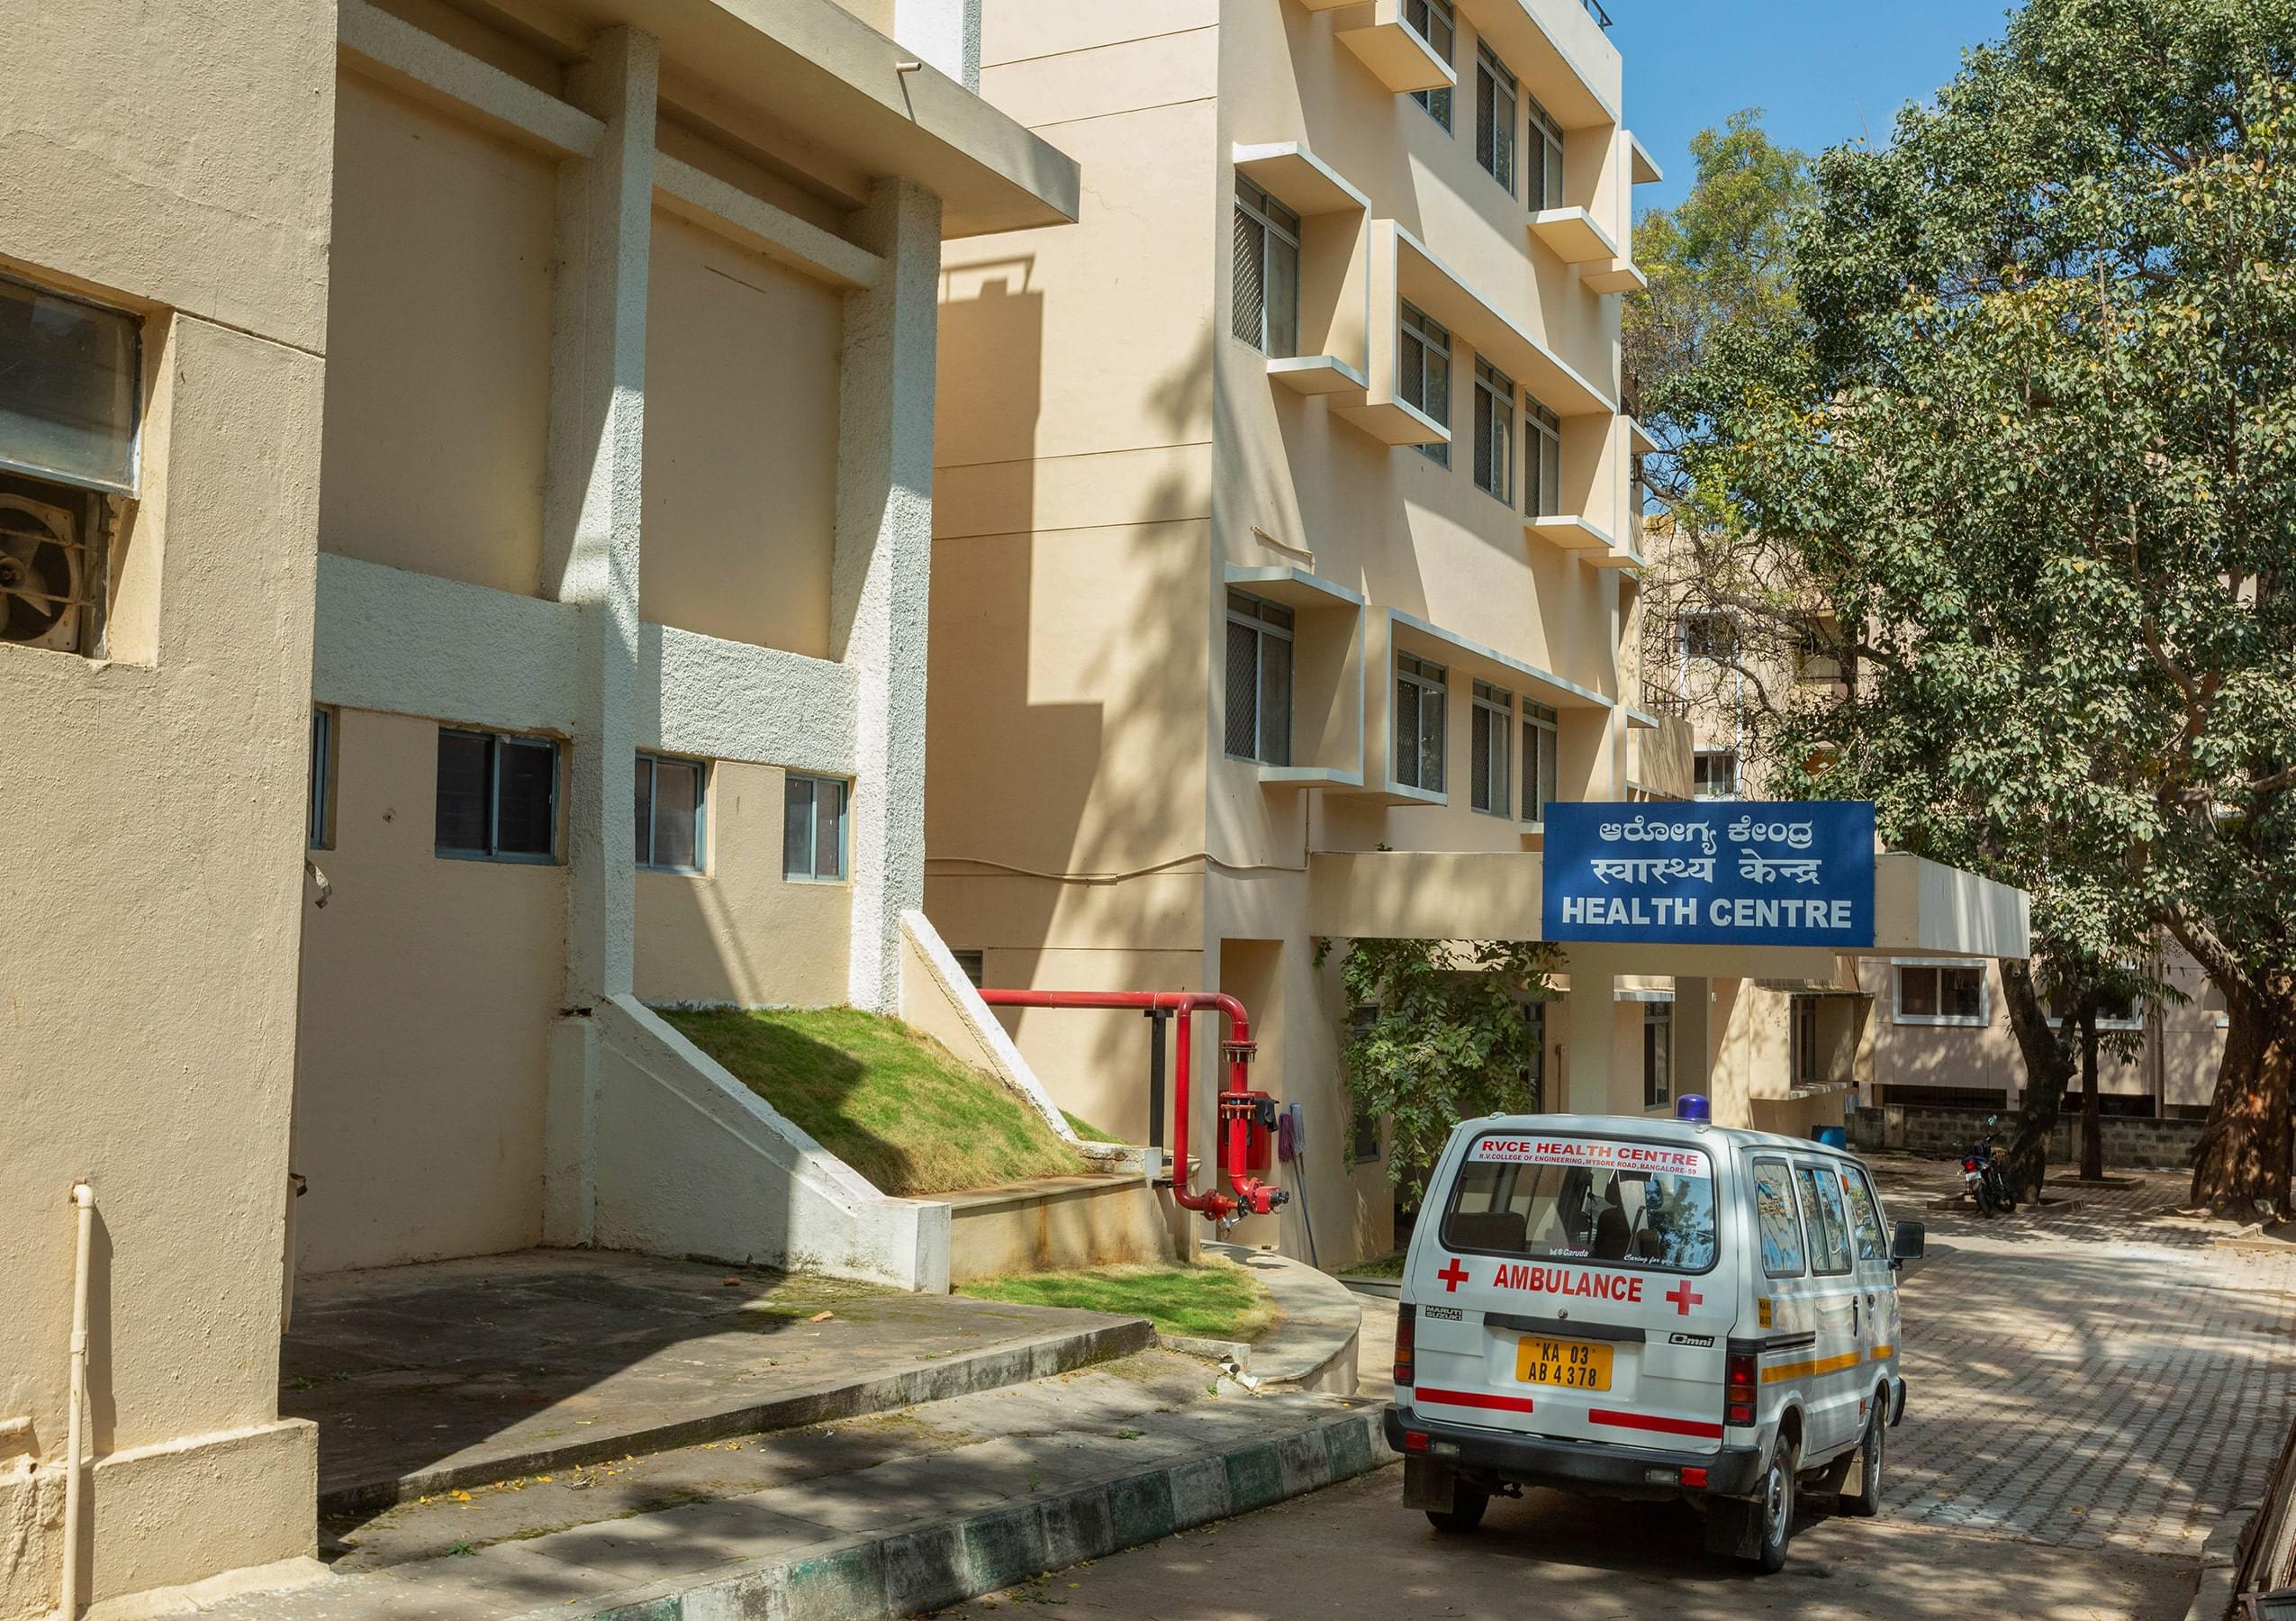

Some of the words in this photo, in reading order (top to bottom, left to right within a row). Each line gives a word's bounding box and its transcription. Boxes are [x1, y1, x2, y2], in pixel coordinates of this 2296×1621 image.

[1599, 815, 1717, 856] ಆರೋಗ್ಯ
[1728, 815, 1812, 849] ಕೇಂದ್ರ
[1590, 857, 1716, 884] स्वास्थ्य
[1739, 848, 1822, 884] केन्द्र
[1562, 896, 1697, 926] HEALTH
[1709, 898, 1852, 928] CENTRE
[1482, 1140, 1531, 1153] RVCE
[1536, 1142, 1612, 1158] HEALTH
[1617, 1147, 1699, 1167] CENTRE
[1623, 1254, 1648, 1263] Caring
[1649, 1256, 1659, 1264] for
[1493, 1263, 1643, 1303] AMBULANCE
[1426, 1306, 1461, 1316] MARUTI
[1426, 1311, 1461, 1320] SUZUKI
[1670, 1334, 1713, 1346] Omni
[1541, 1343, 1559, 1362] KA
[1570, 1345, 1588, 1364] 03
[1528, 1362, 1548, 1381] AB
[1553, 1364, 1596, 1387] 4378
